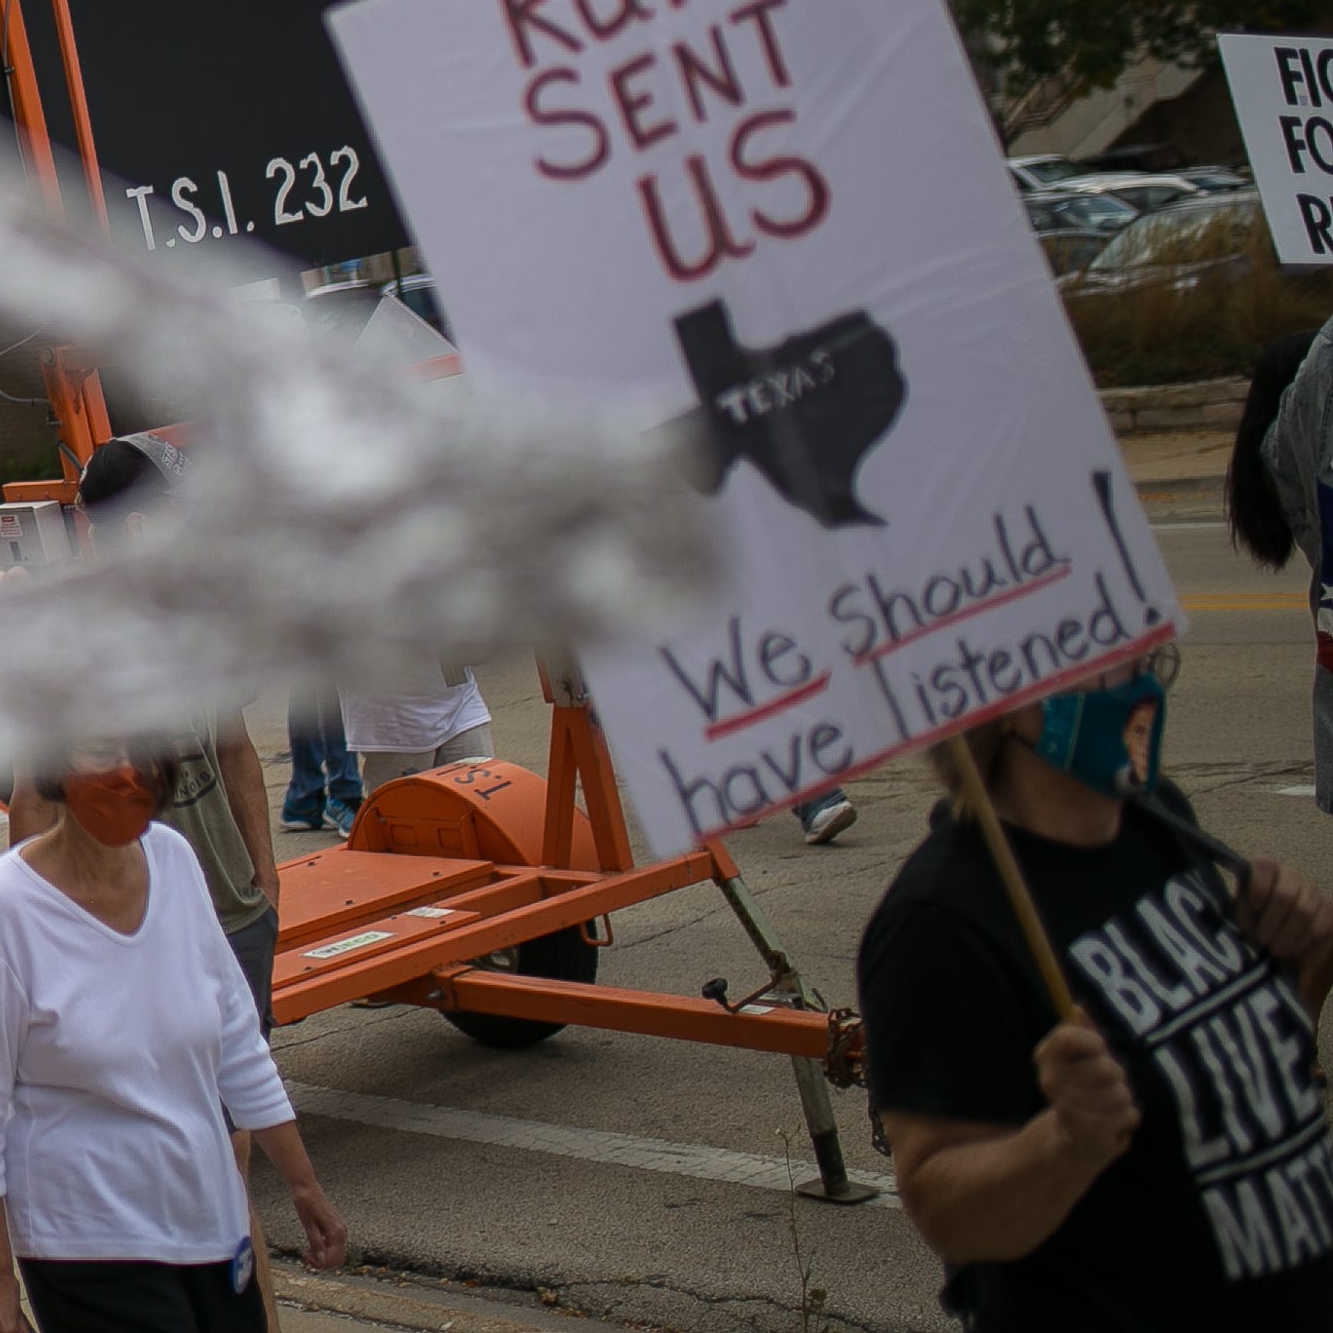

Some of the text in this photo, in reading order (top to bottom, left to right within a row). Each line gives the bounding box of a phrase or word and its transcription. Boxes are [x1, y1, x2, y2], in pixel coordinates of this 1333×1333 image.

[126, 146, 368, 250] T.S.I. 232
[637, 108, 832, 284] US
[1296, 194, 1333, 254] R
[716, 347, 834, 423] TEXAS
[659, 503, 1071, 722] We Should
[659, 721, 854, 836] have
